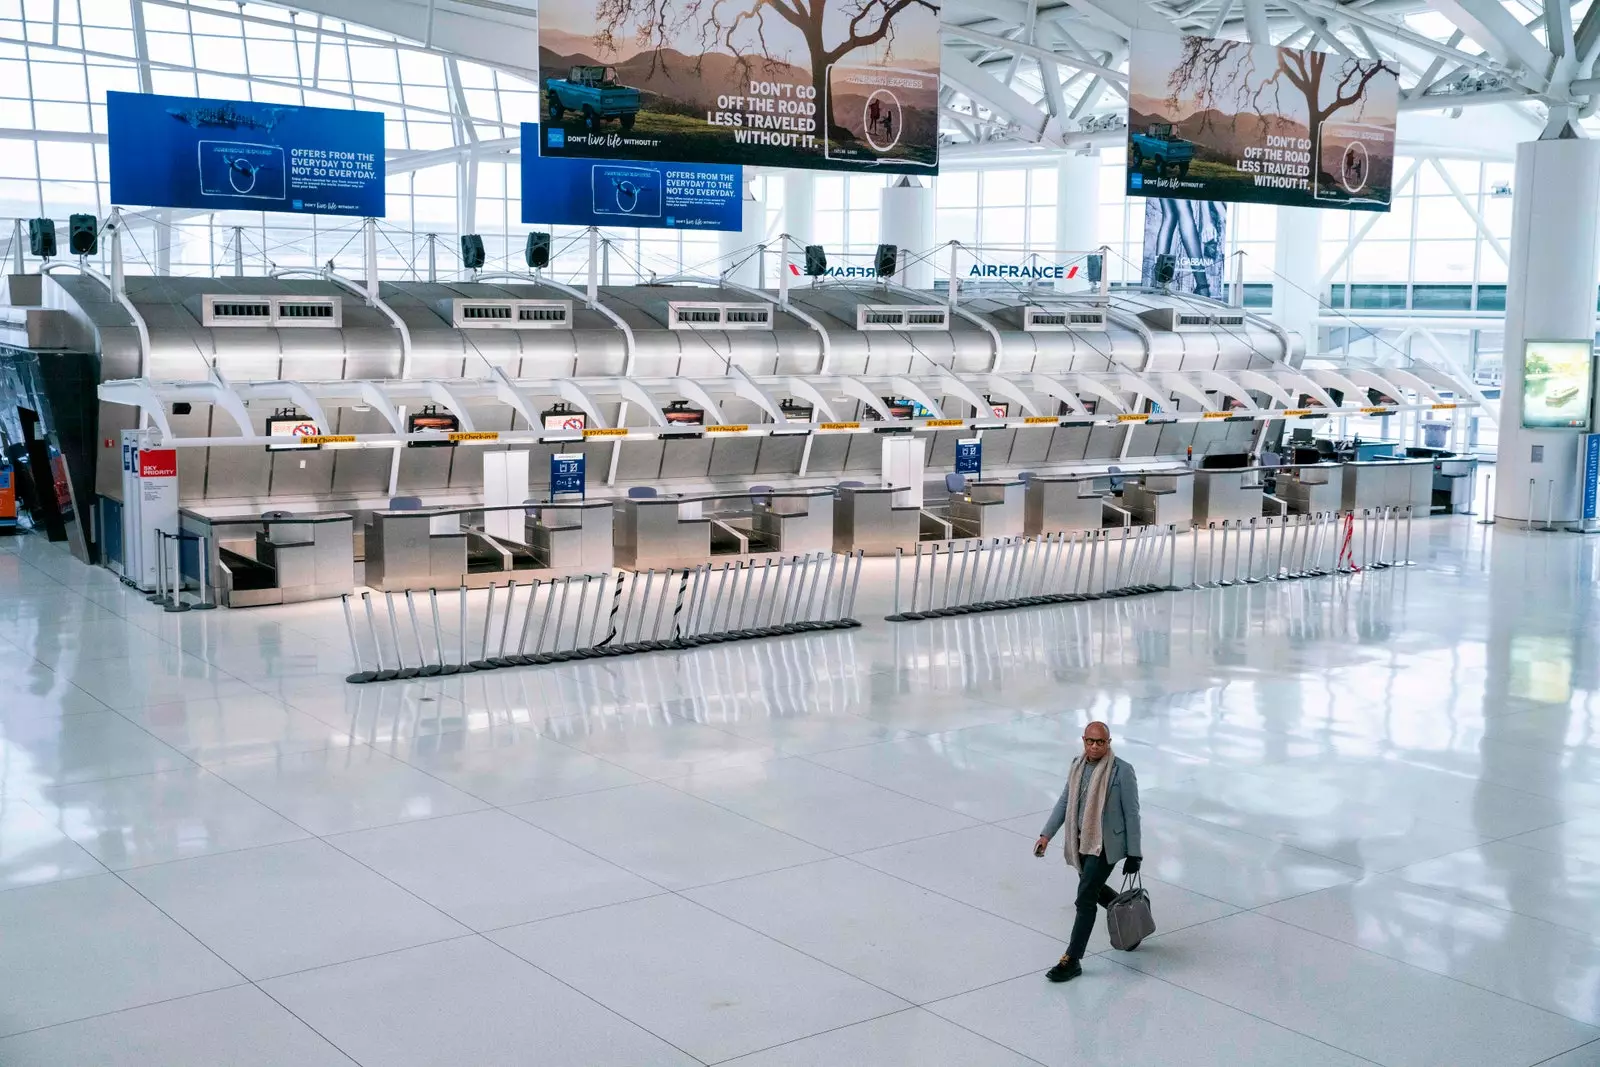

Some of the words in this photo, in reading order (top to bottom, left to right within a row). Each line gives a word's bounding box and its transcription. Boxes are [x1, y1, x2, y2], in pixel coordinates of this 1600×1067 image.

[750, 81, 793, 97] DON'T
[796, 85, 816, 99] GO
[718, 95, 744, 109] OFF
[747, 97, 774, 112] THE
[779, 100, 816, 115] ROAD
[707, 112, 742, 126] LESS
[746, 114, 816, 132] TRAVELED
[588, 133, 605, 146] live
[606, 134, 623, 148] life
[734, 130, 799, 147] WITHOUT
[802, 135, 818, 148] IT.
[1267, 135, 1296, 148] DON'T
[1298, 139, 1311, 150] GO
[291, 149, 327, 158] OFFERS
[329, 151, 355, 160] FROM
[357, 153, 375, 161] THE
[1244, 147, 1262, 159] OFF
[1264, 149, 1282, 160] THE
[1285, 151, 1310, 164] ROAD
[292, 158, 339, 168] EVERYDAY
[355, 162, 373, 170] THE
[1236, 160, 1260, 172] LESS
[1263, 162, 1309, 176] TRAVELED
[292, 167, 312, 175] NOT
[329, 169, 376, 179] EVERYDAY.
[666, 171, 695, 179] OFFERS
[666, 179, 705, 188] EVERYDAY
[1254, 175, 1297, 189] WITHOUT
[1299, 179, 1310, 190] IT.
[697, 189, 735, 197] EVERYDAY.
[970, 265, 1064, 278] AIRFRANCE
